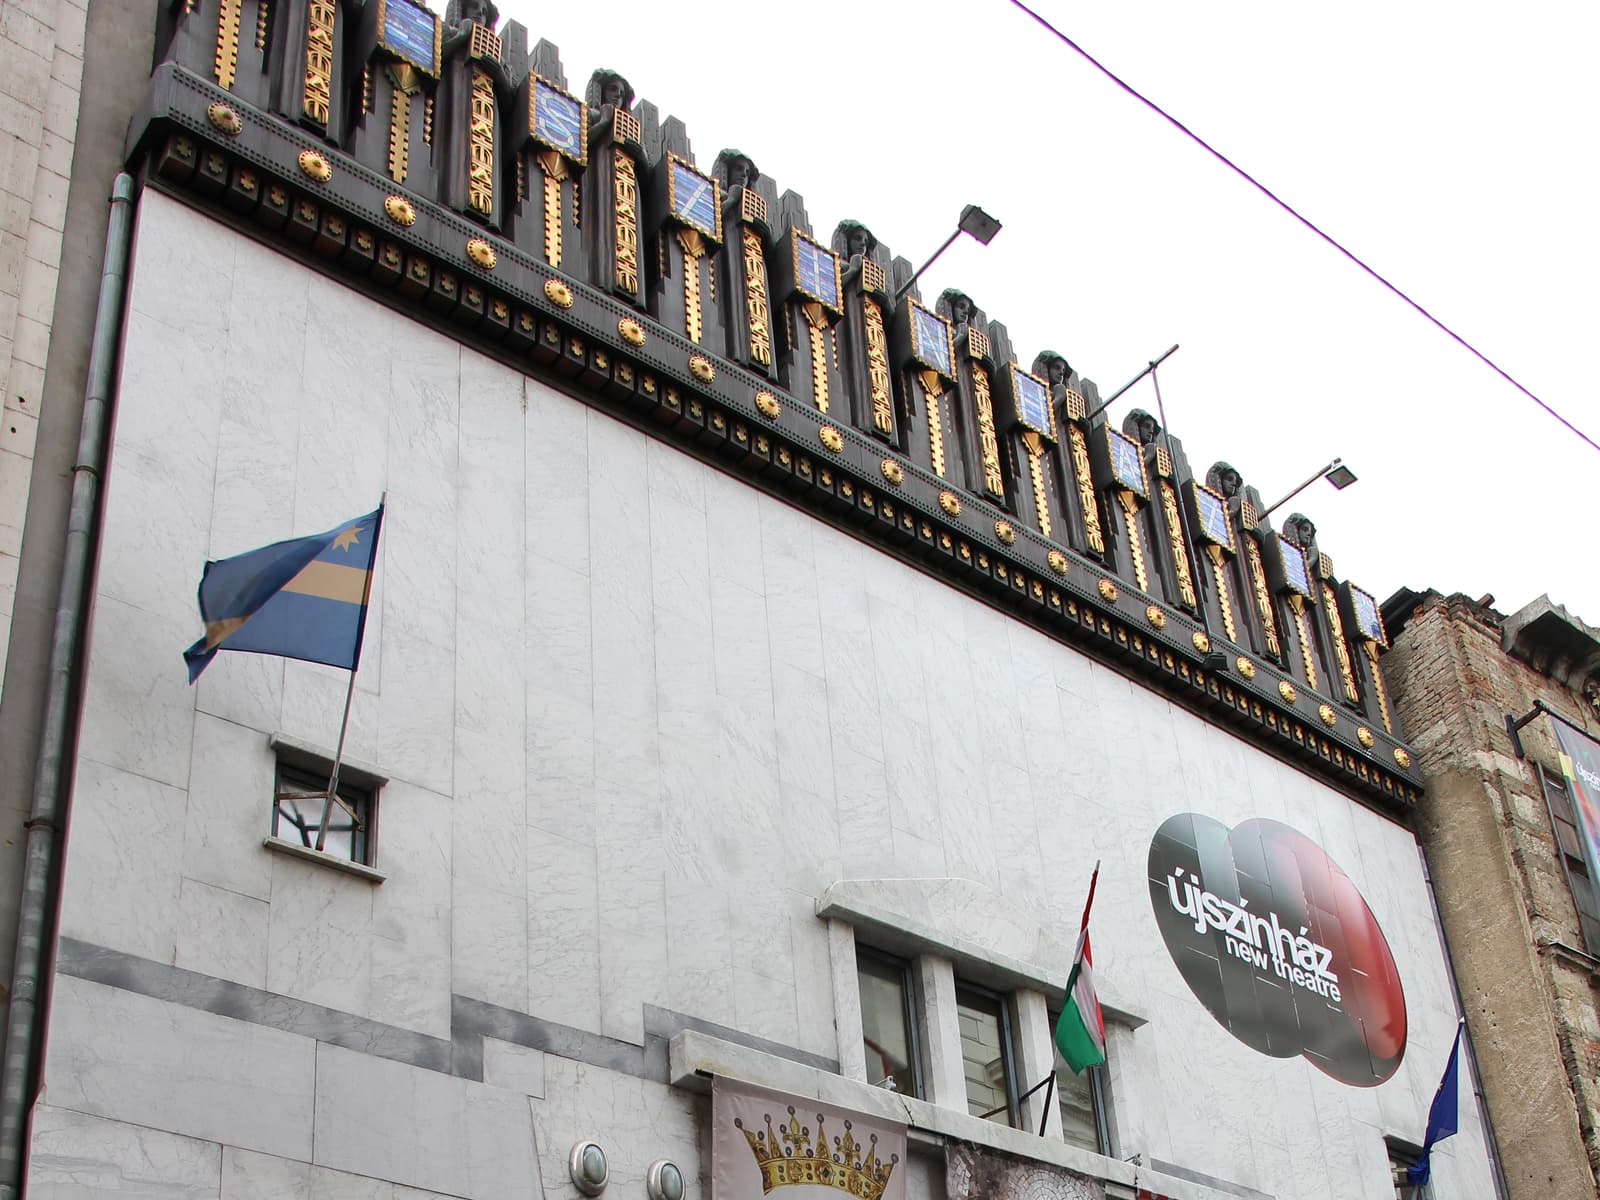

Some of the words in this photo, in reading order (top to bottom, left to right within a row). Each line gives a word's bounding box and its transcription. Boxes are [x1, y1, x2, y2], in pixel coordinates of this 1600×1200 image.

[1167, 867, 1338, 983] újszínház
[1225, 935, 1268, 971] new
[1271, 951, 1342, 1002] theatre
